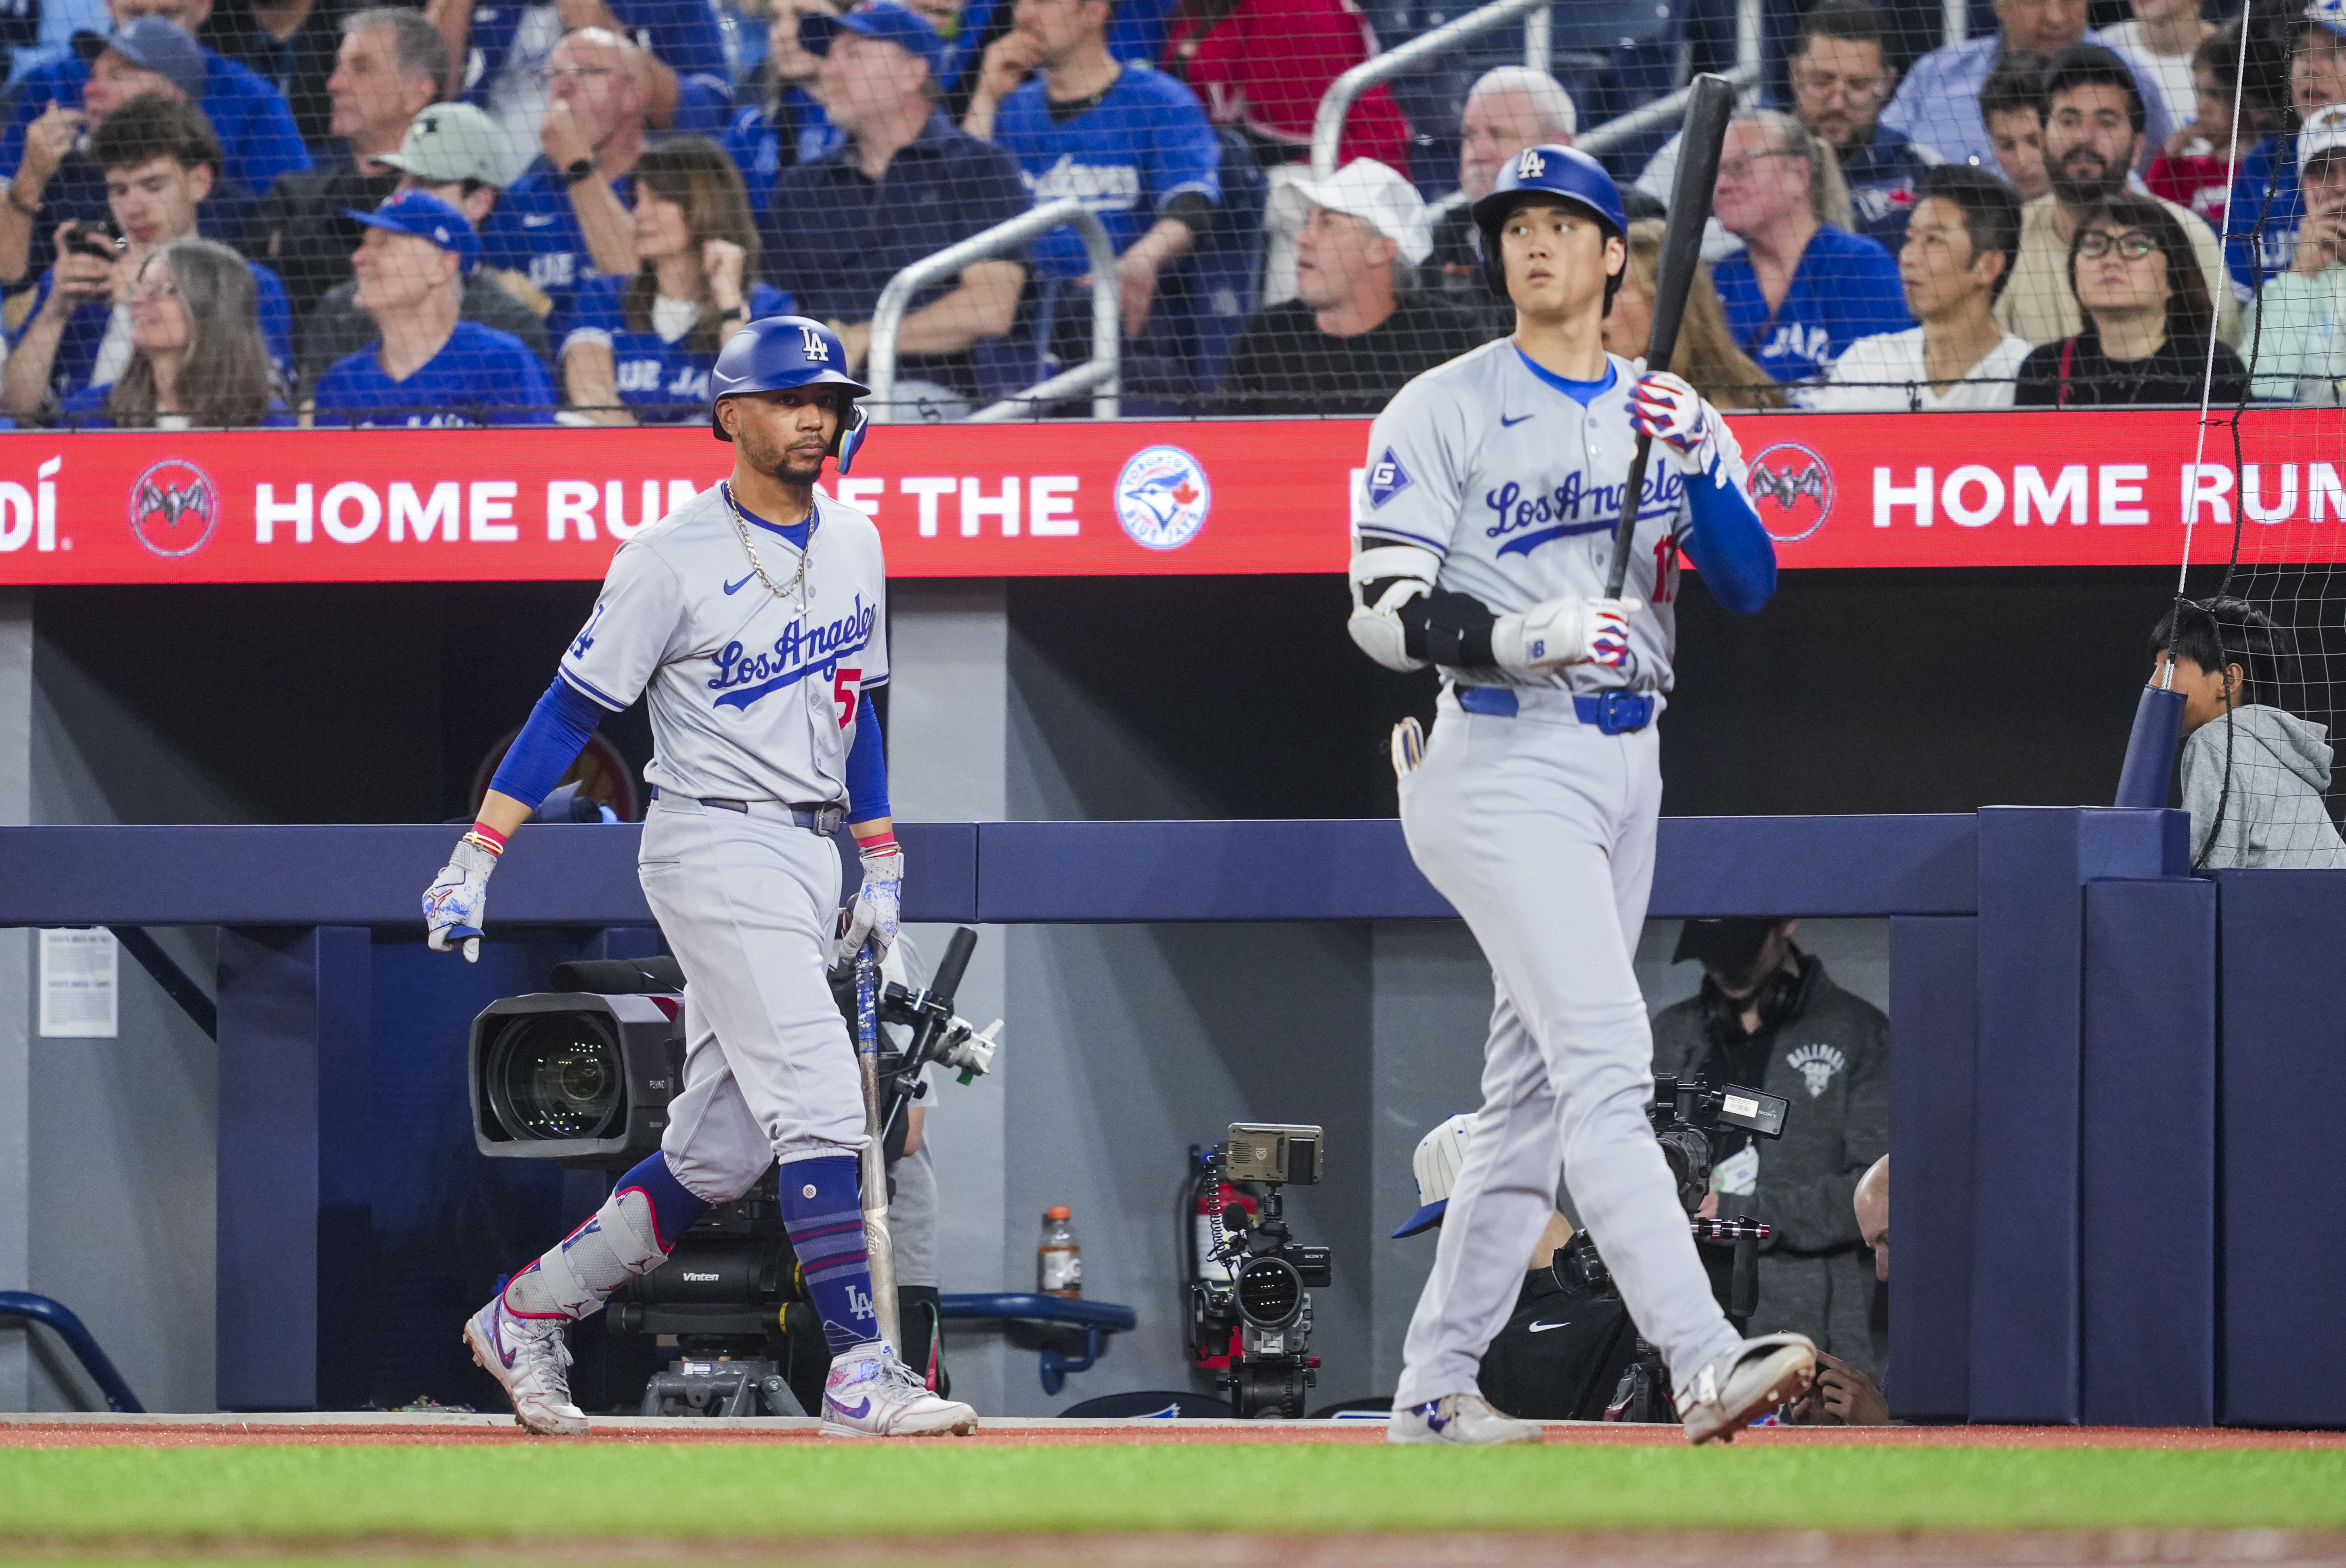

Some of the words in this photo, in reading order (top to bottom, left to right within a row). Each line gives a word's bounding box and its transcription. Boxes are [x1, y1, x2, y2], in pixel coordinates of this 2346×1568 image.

[1518, 147, 1545, 180] LA
[799, 326, 829, 361] LA
[256, 481, 518, 543] HOME
[901, 476, 1079, 536] THE
[1486, 481, 1552, 537] Los
[1873, 465, 2149, 527] HOME
[708, 640, 770, 689] Los
[771, 592, 876, 682] Angele
[834, 668, 862, 730] 5
[1758, 1109, 1777, 1118] SONY
[683, 1272, 719, 1281] Vinten
[845, 1285, 875, 1321] LA
